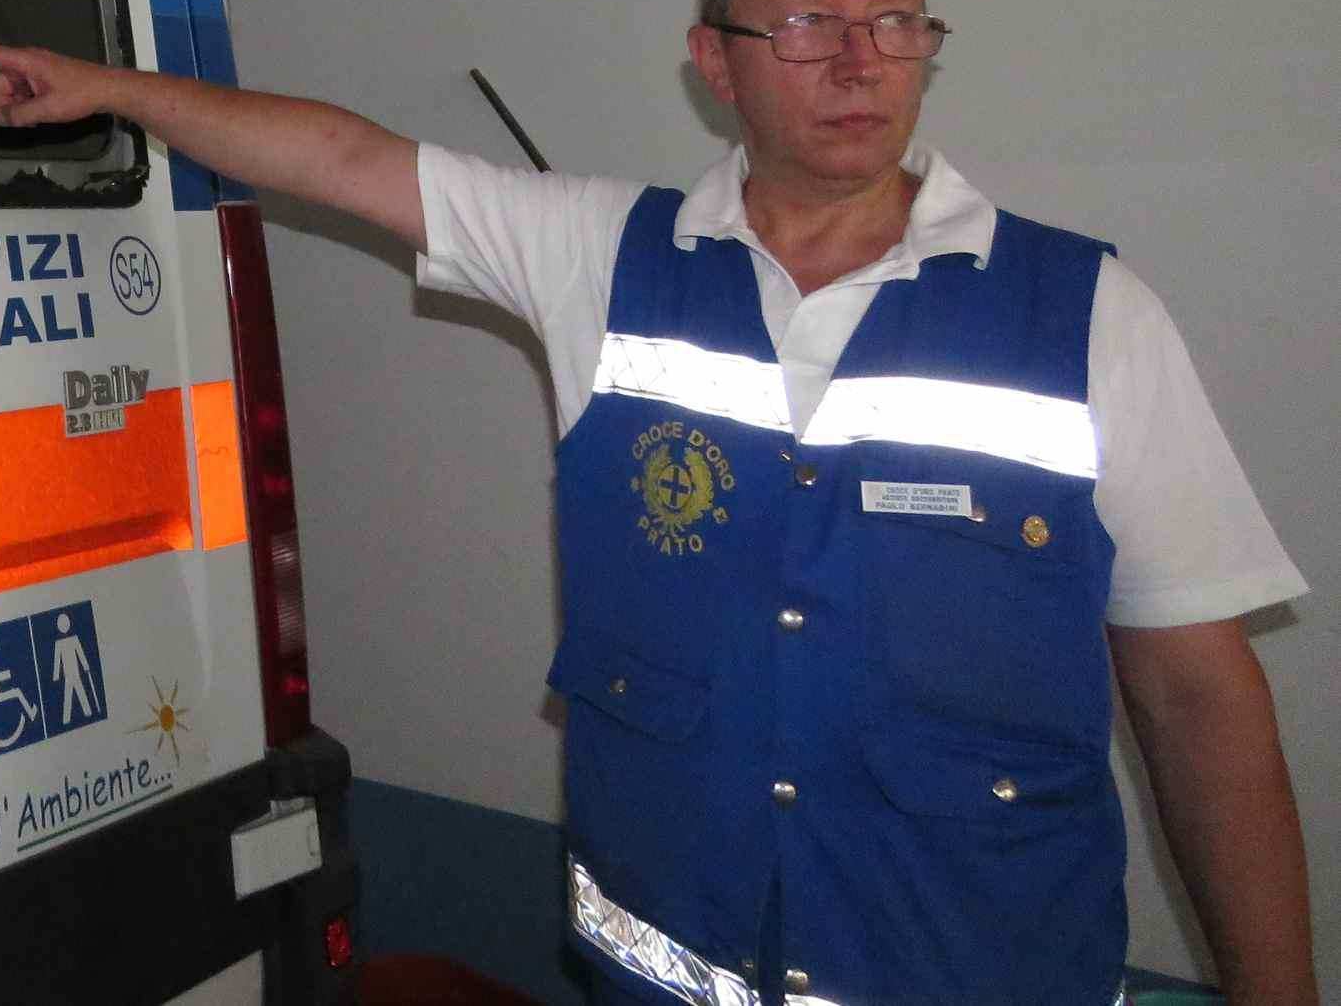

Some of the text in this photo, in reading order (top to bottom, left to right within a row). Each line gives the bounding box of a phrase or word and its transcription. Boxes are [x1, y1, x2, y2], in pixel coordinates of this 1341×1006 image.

[115, 252, 155, 302] S54
[63, 364, 149, 410] Daily
[632, 421, 736, 491] CROCE D'ORO
[637, 516, 703, 556] PRATO
[17, 758, 173, 838] Ambiente...
